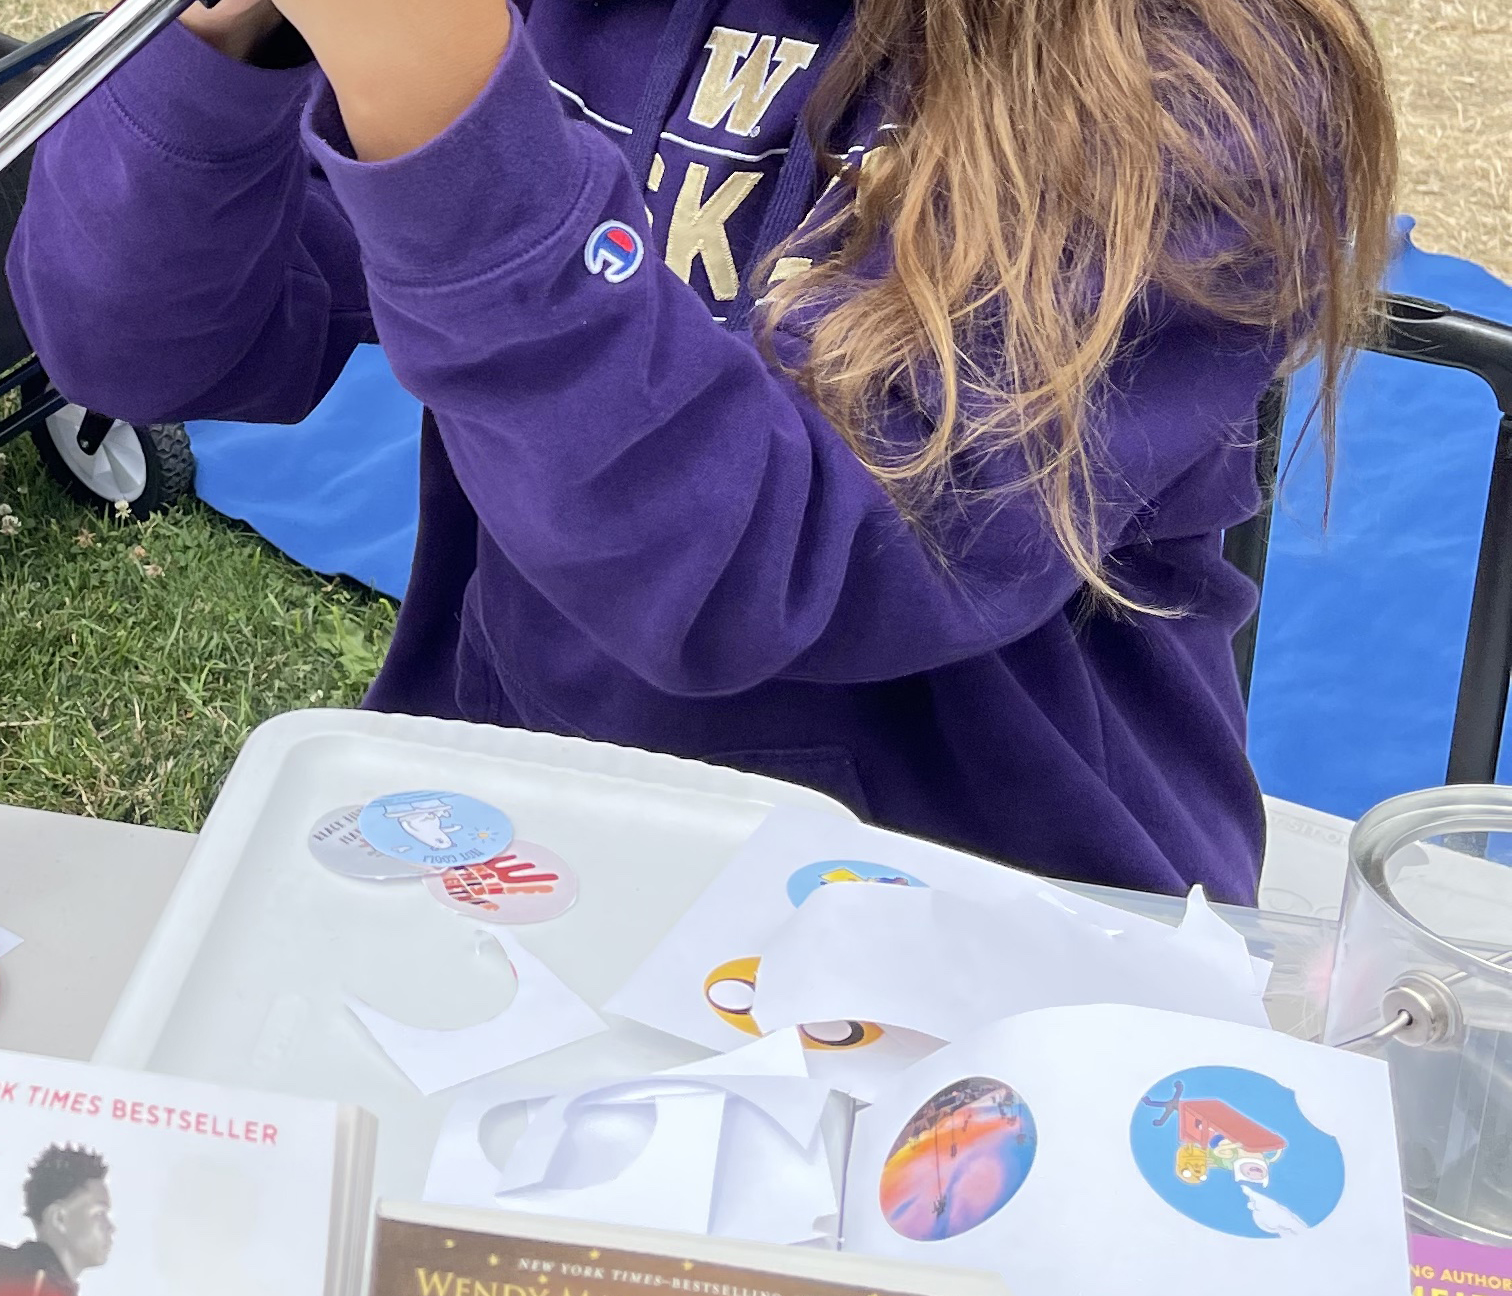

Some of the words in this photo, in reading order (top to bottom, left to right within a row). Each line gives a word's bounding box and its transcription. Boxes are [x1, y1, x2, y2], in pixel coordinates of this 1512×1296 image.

[688, 25, 820, 137] W
[458, 847, 485, 861] NOT
[27, 1085, 103, 1118] TIMES
[111, 1098, 280, 1145] BESTSELLER
[517, 1257, 556, 1273] NEW
[560, 1262, 605, 1280] YORK
[1439, 1268, 1512, 1292] AUTHOR
